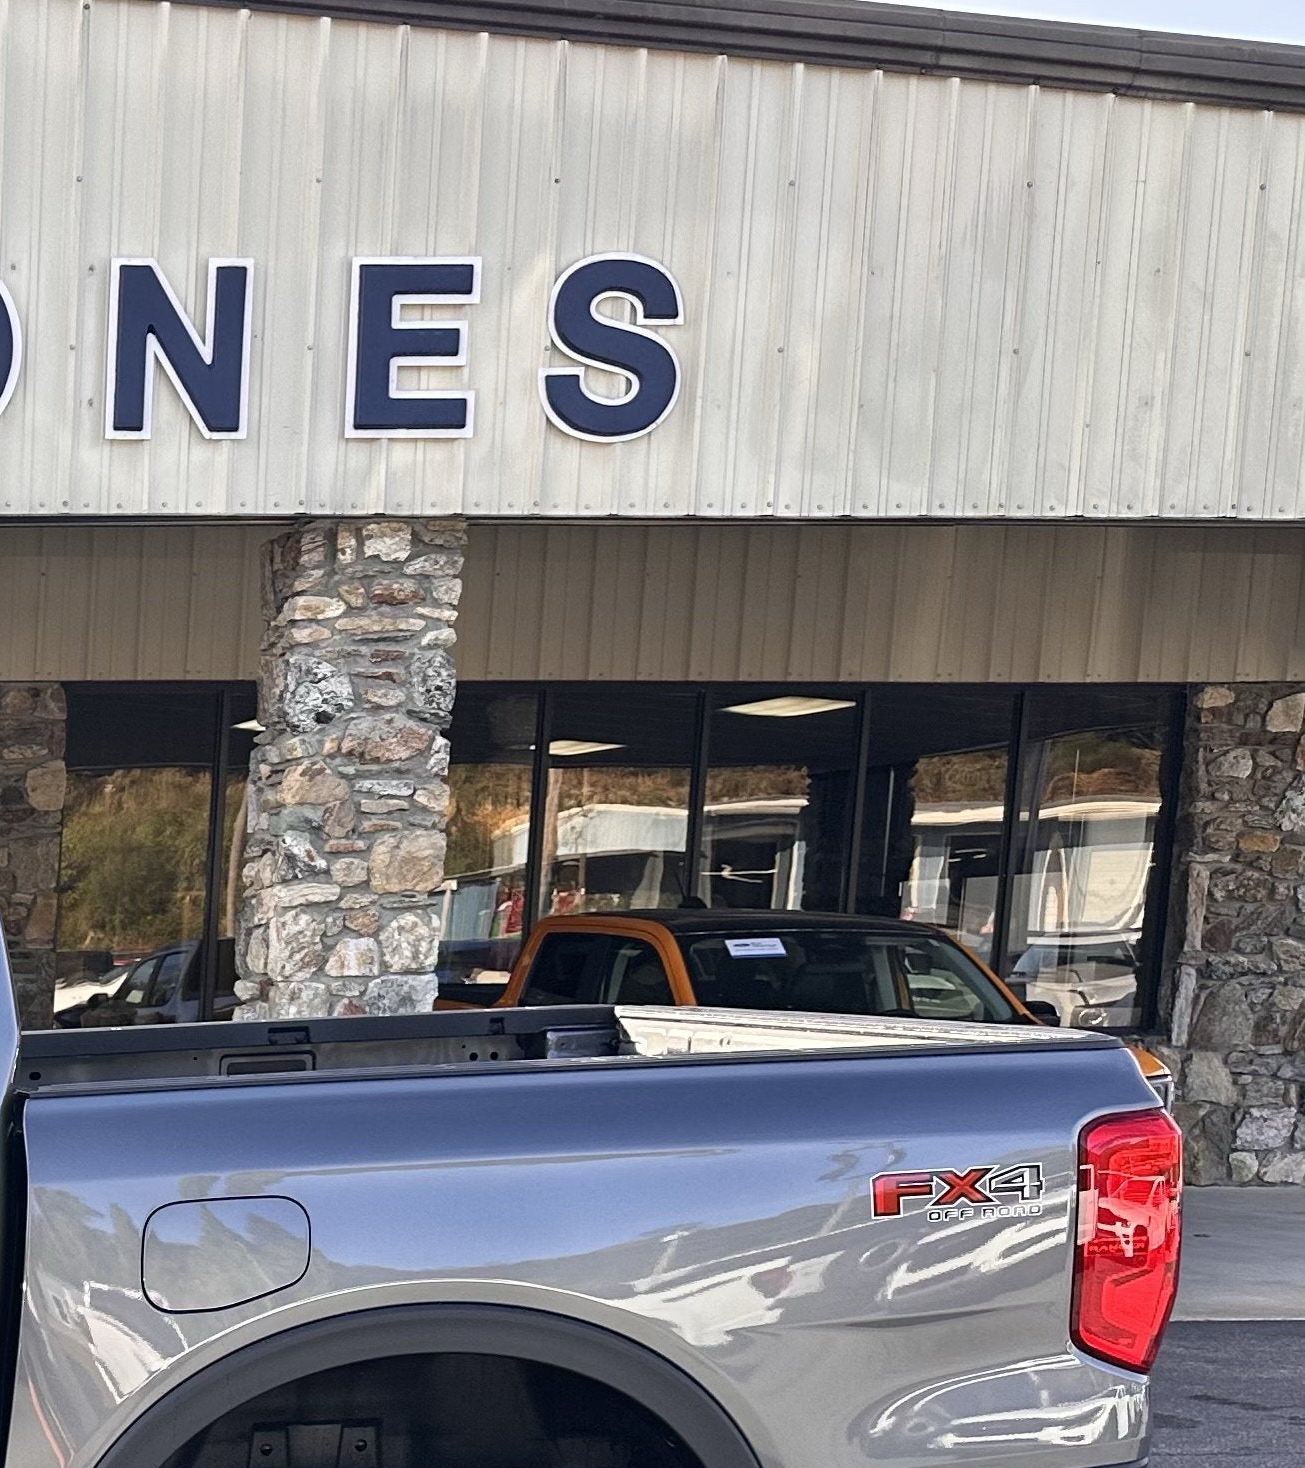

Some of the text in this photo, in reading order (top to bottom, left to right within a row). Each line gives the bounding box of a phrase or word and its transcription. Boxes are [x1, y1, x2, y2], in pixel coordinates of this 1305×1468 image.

[870, 1162, 1045, 1219] FX4
[927, 1204, 1041, 1222] OFF ROAD
